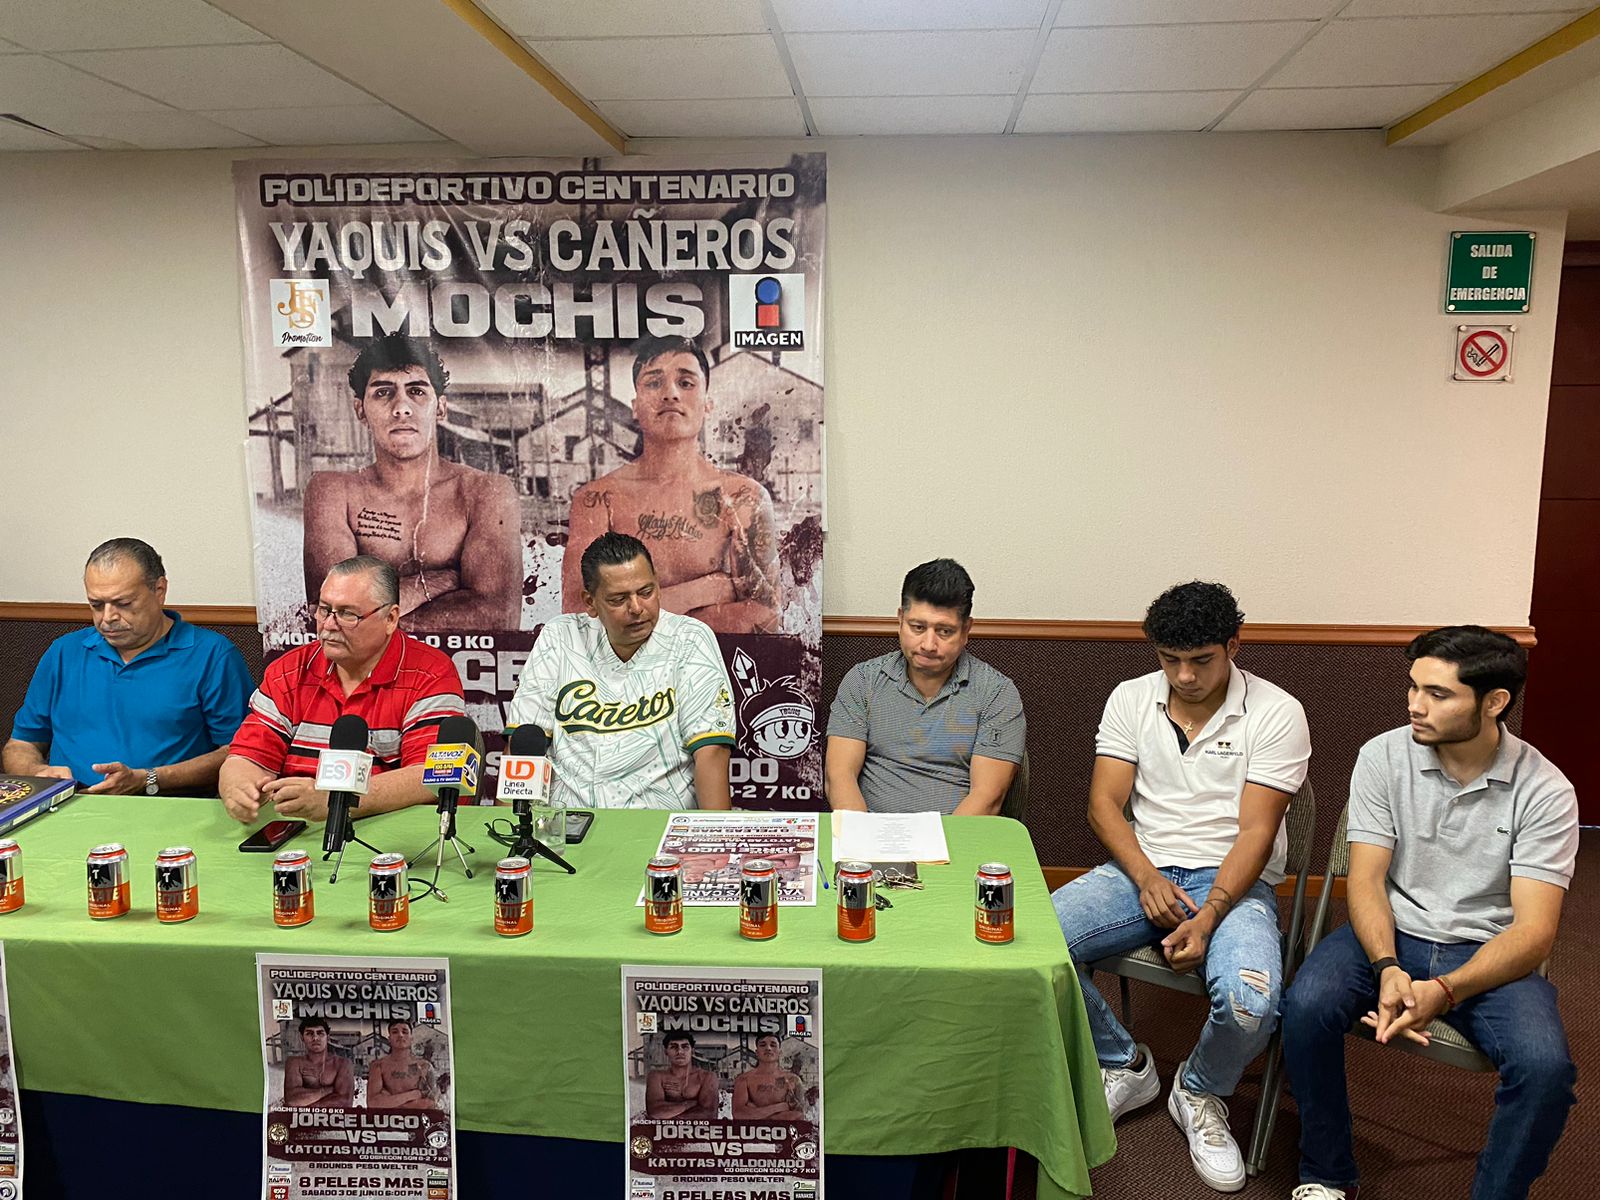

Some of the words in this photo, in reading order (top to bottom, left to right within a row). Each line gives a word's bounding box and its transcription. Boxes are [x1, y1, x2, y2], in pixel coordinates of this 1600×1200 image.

[264, 176, 551, 202] POLIDEPORTIVO
[559, 173, 795, 200] CENTENARIO
[269, 220, 451, 279] YAQUIS
[464, 220, 533, 271] VS
[549, 207, 797, 271] CAÑEROS
[1470, 244, 1513, 258] SALIDA
[1482, 266, 1498, 279] DE
[1450, 287, 1526, 301] EMERGENCIA
[353, 282, 705, 339] MOCHIS
[281, 331, 324, 345] Promotion
[736, 332, 802, 346] IMAGEN
[447, 635, 463, 649] 8
[465, 635, 495, 649] KO
[554, 679, 677, 728] Cañeros
[503, 787, 533, 796] Directa
[764, 785, 779, 799] 7
[782, 785, 811, 800] KO
[270, 969, 363, 981] POLIDEPORTIVO
[364, 973, 438, 982] CENTENARIO
[273, 982, 331, 1001] YAQUIS
[335, 984, 358, 999] VS
[361, 983, 438, 1002] CAÑEROS
[635, 982, 732, 992] POLIDEPORTIVO
[733, 984, 810, 994] CENTENARIO
[300, 1002, 411, 1020] MOCHIS
[637, 995, 698, 1013] YAQUIS
[701, 997, 725, 1012] VS
[729, 994, 810, 1014] CAÑEROS
[663, 1014, 780, 1033] MOCHIS
[290, 1112, 358, 1129] JORGE
[361, 1114, 420, 1129] LUGO
[345, 1130, 378, 1144] VS
[653, 1125, 723, 1141] JORGE
[727, 1127, 787, 1141] LUGO
[285, 1144, 350, 1155] KATOTAS
[353, 1146, 438, 1157] MALDONADO
[710, 1142, 743, 1156] VS
[316, 1162, 353, 1170] ROUNDS
[648, 1157, 716, 1168] KATOTAS
[718, 1158, 806, 1168] MALDONADO
[299, 1176, 311, 1188] 8
[314, 1176, 382, 1188] PELEAS
[385, 1177, 424, 1189] MAS
[358, 1190, 384, 1198] JUNIO
[679, 1190, 747, 1200] PELEAS
[750, 1191, 791, 1200] MAS
